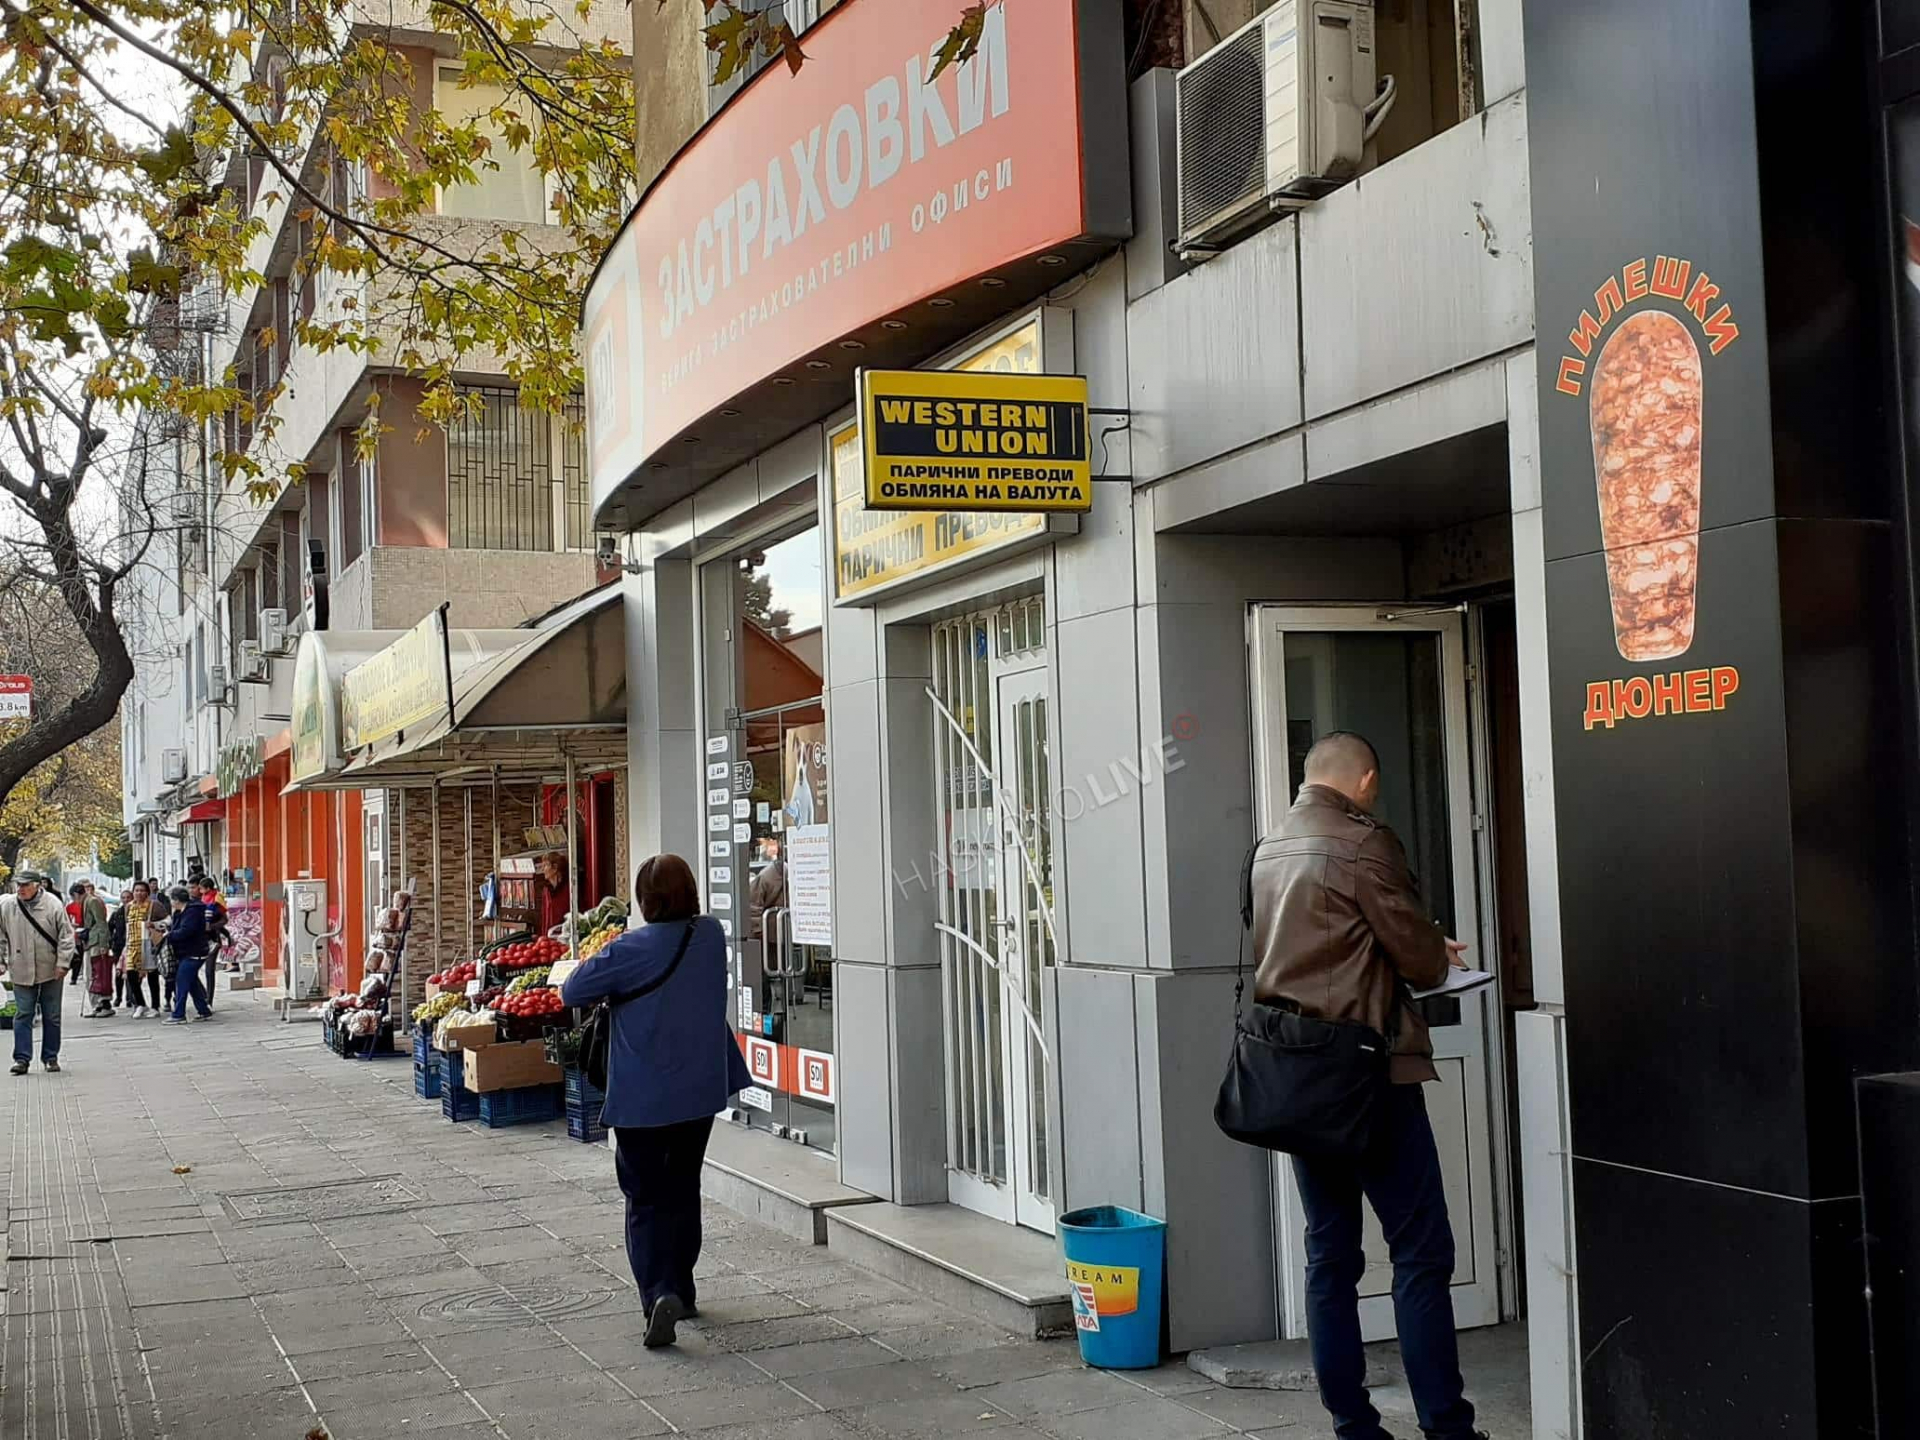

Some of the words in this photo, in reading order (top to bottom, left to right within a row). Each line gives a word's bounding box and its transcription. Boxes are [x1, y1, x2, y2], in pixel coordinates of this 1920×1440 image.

[657, 2, 1011, 340] ЗАСТРАХОВКИ
[712, 222, 891, 357] ЗАСТРАХОВАТЕЛНИ
[910, 157, 1012, 233] ОФИСИ
[1555, 255, 1740, 396] ПИЛЕШКИ
[879, 400, 1047, 429] WESTERN
[934, 428, 1048, 455] UNION
[880, 482, 970, 499] ОБМЯНА
[974, 484, 1002, 500] НА
[1007, 484, 1083, 501] ВАЛУТА
[889, 464, 980, 480] ПАРИЧНИ
[987, 467, 1074, 483] ПРЕВОДИ
[840, 523, 924, 587] ПАРИЧНИ
[1583, 667, 1740, 730] ДЮНЕР
[1065, 1264, 1123, 1285] REAM
